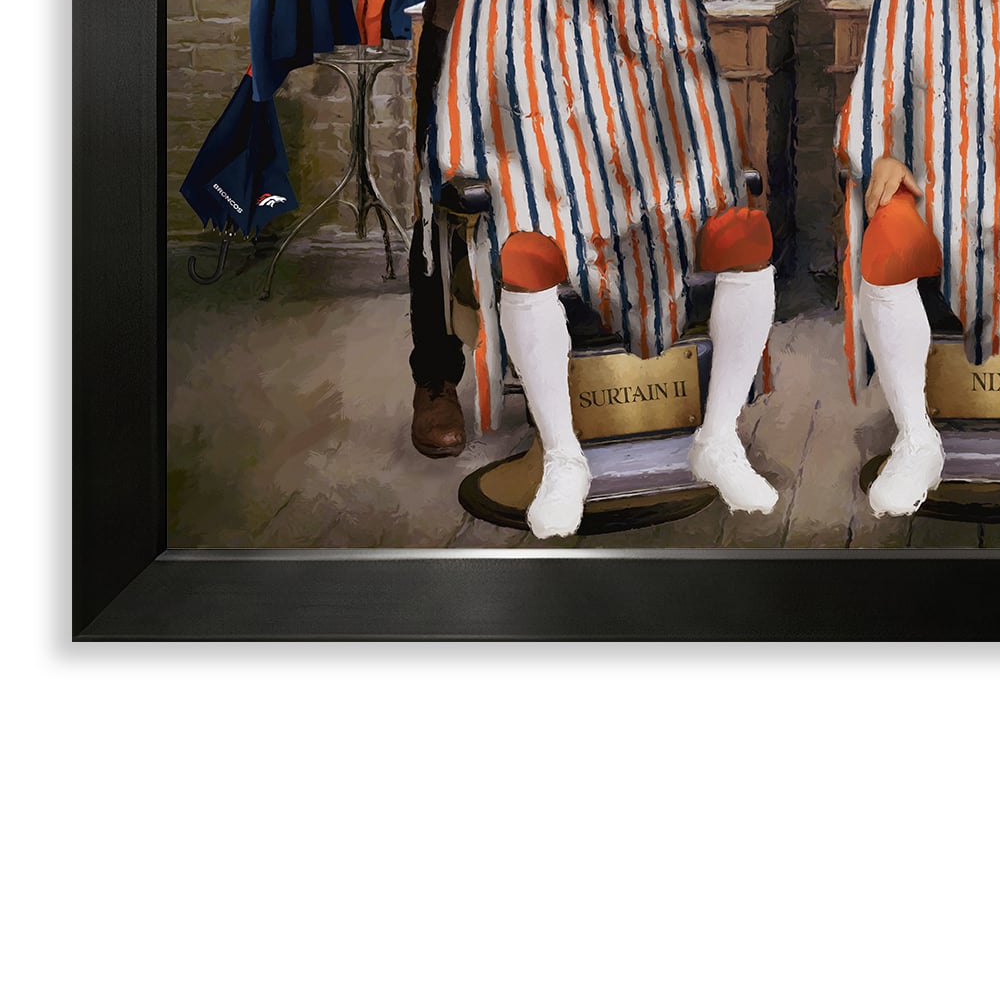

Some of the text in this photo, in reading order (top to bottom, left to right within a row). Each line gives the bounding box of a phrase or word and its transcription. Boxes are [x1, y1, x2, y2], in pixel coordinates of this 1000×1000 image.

[212, 183, 244, 214] BRONCOS
[579, 380, 688, 409] SURTAIN II
